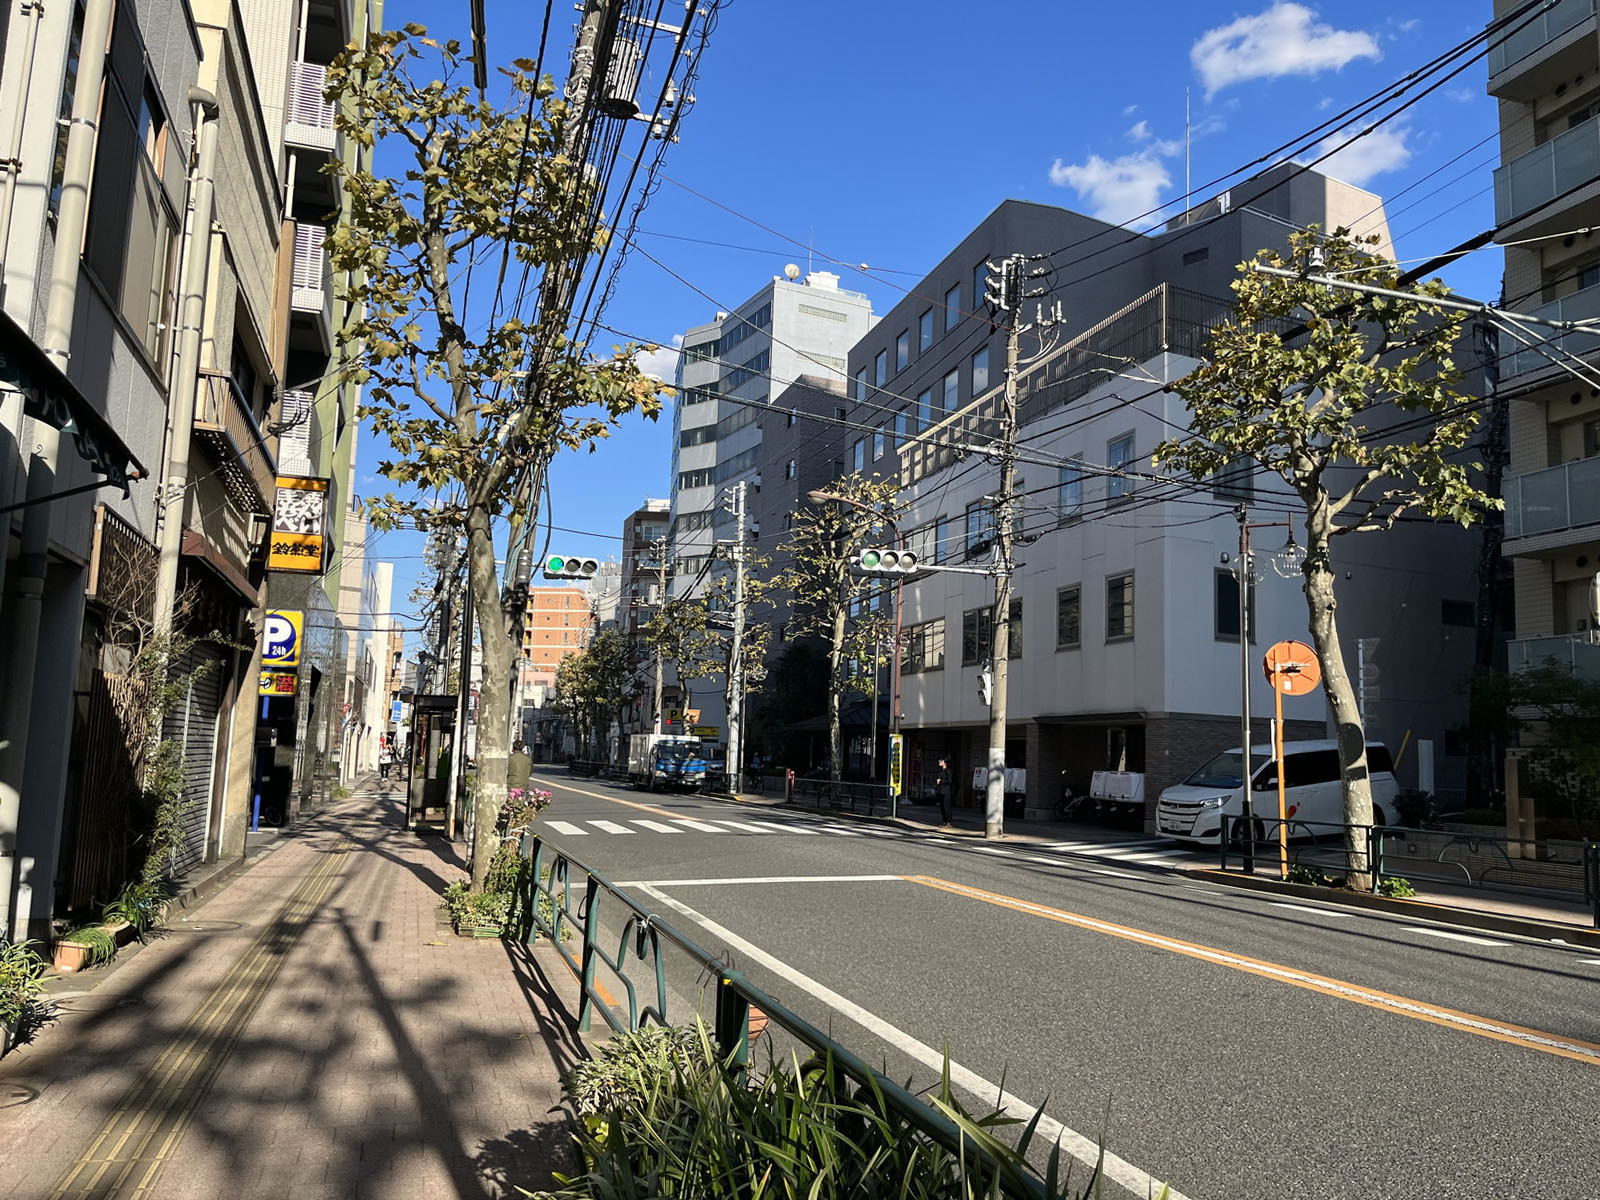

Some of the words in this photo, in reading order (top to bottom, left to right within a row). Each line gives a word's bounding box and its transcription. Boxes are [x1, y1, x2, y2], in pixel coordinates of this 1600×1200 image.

[262, 617, 292, 655] P
[272, 645, 287, 656] 24h
[275, 675, 294, 693] 満
